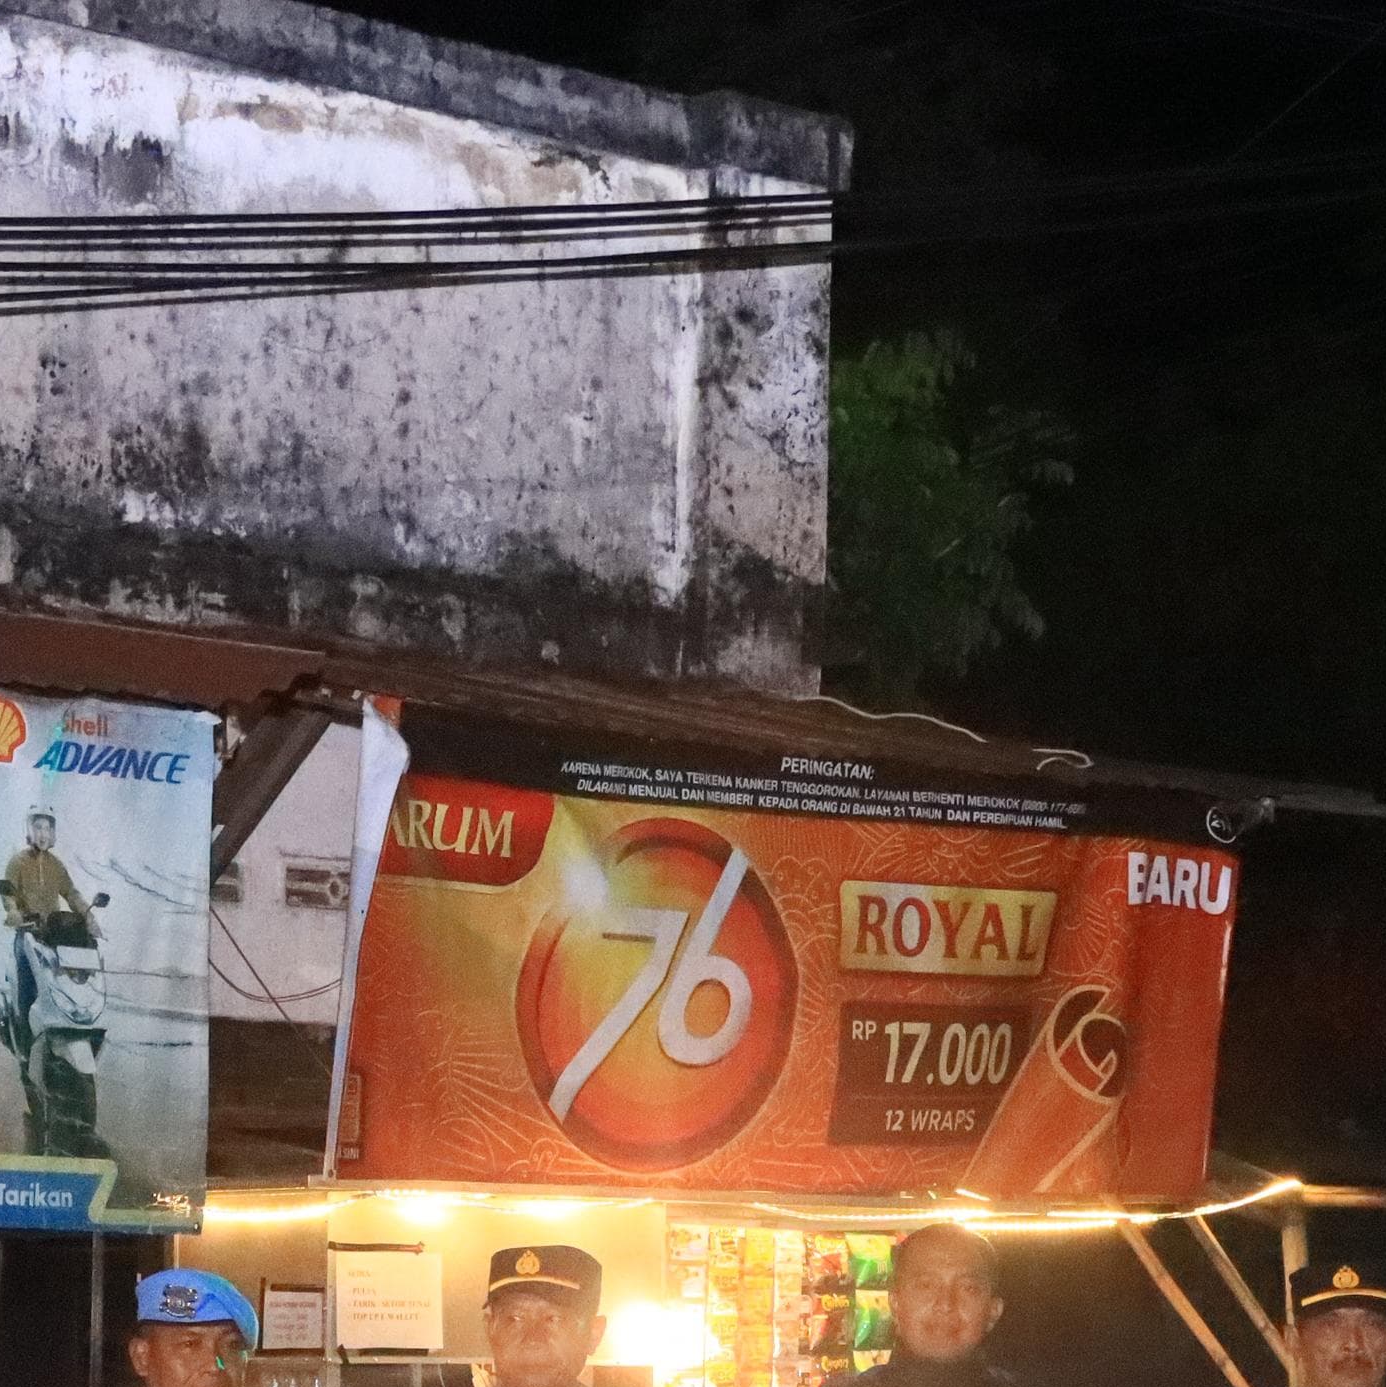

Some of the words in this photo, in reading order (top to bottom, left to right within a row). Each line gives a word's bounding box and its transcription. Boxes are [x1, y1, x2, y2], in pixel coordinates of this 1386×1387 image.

[33, 740, 190, 784] ADVANCE
[561, 761, 601, 776] KARENA
[603, 765, 653, 782] MEROKOK,
[655, 770, 684, 783] SAYA
[686, 772, 732, 788] TERKENA
[735, 777, 778, 791] KANKER
[864, 788, 910, 802] LAYANAN
[913, 791, 964, 806] BERHENTI
[967, 795, 1020, 809] MEROKOK
[780, 757, 875, 781] PERINGATAN:
[577, 779, 626, 795] DILARANG
[628, 784, 679, 799] MENJUAL
[681, 788, 705, 801] DAN
[706, 791, 753, 806] MEMBERI
[758, 796, 799, 810] KEPADA
[801, 799, 838, 813] ORANG
[840, 803, 851, 815] DI
[853, 804, 891, 817] BAWAH
[893, 806, 905, 817] 21
[910, 807, 942, 820] TAHUN
[947, 810, 970, 822] DAN
[973, 812, 1033, 828] PEREMPUAN
[1127, 850, 1232, 916] BARU
[855, 893, 1043, 961] ROYAL
[547, 849, 753, 1125] 76
[852, 1020, 876, 1041] RP
[884, 1022, 1012, 1087] 17.000
[885, 1109, 903, 1131] 12
[911, 1109, 975, 1132] WRAPS
